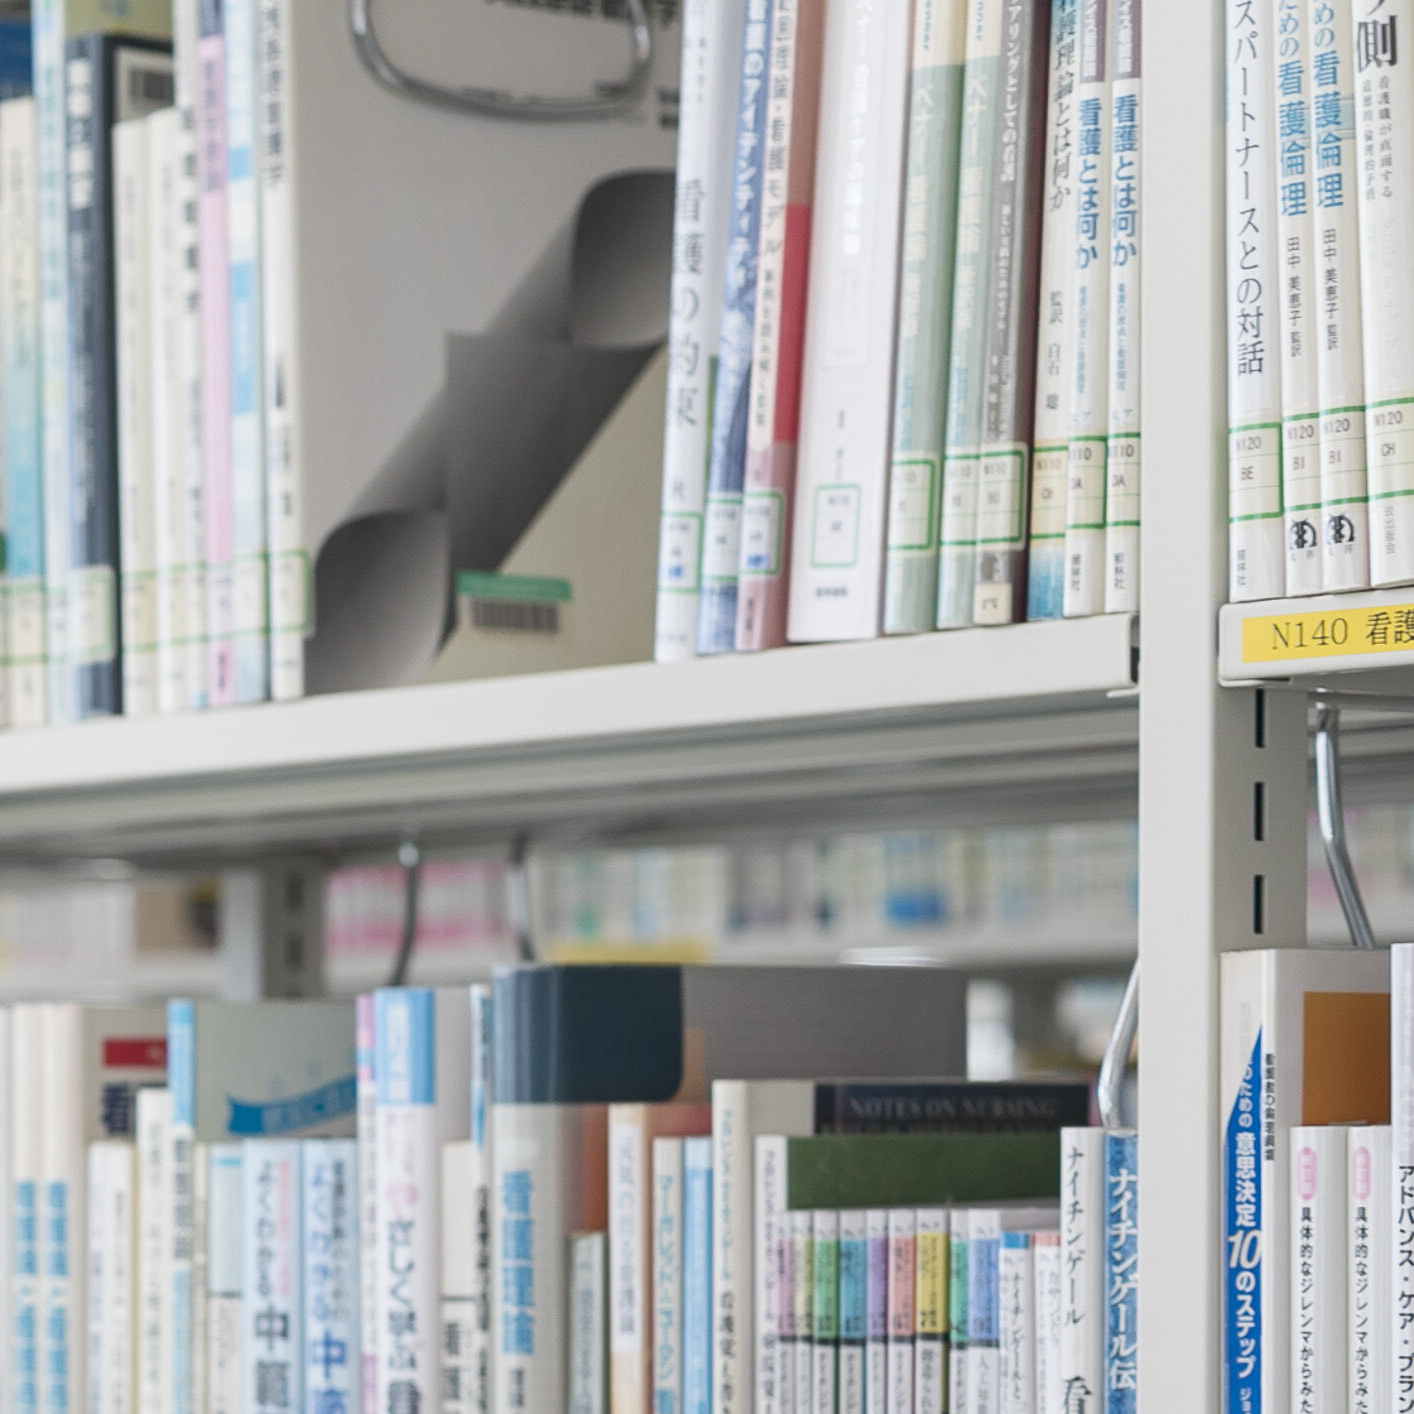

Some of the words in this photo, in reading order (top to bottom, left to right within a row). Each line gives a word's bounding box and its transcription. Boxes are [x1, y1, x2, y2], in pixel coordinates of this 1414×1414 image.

[999, 2, 1023, 183] アリングとしての看護
[1357, 14, 1399, 74] 側
[1076, 97, 1103, 271] 看護とは何か
[1112, 93, 1139, 269] 看護とは何か
[1271, 617, 1349, 651] N140
[1064, 1146, 1086, 1328] ナイチンゲール
[1108, 1168, 1139, 1390] ナイチンゲール伝
